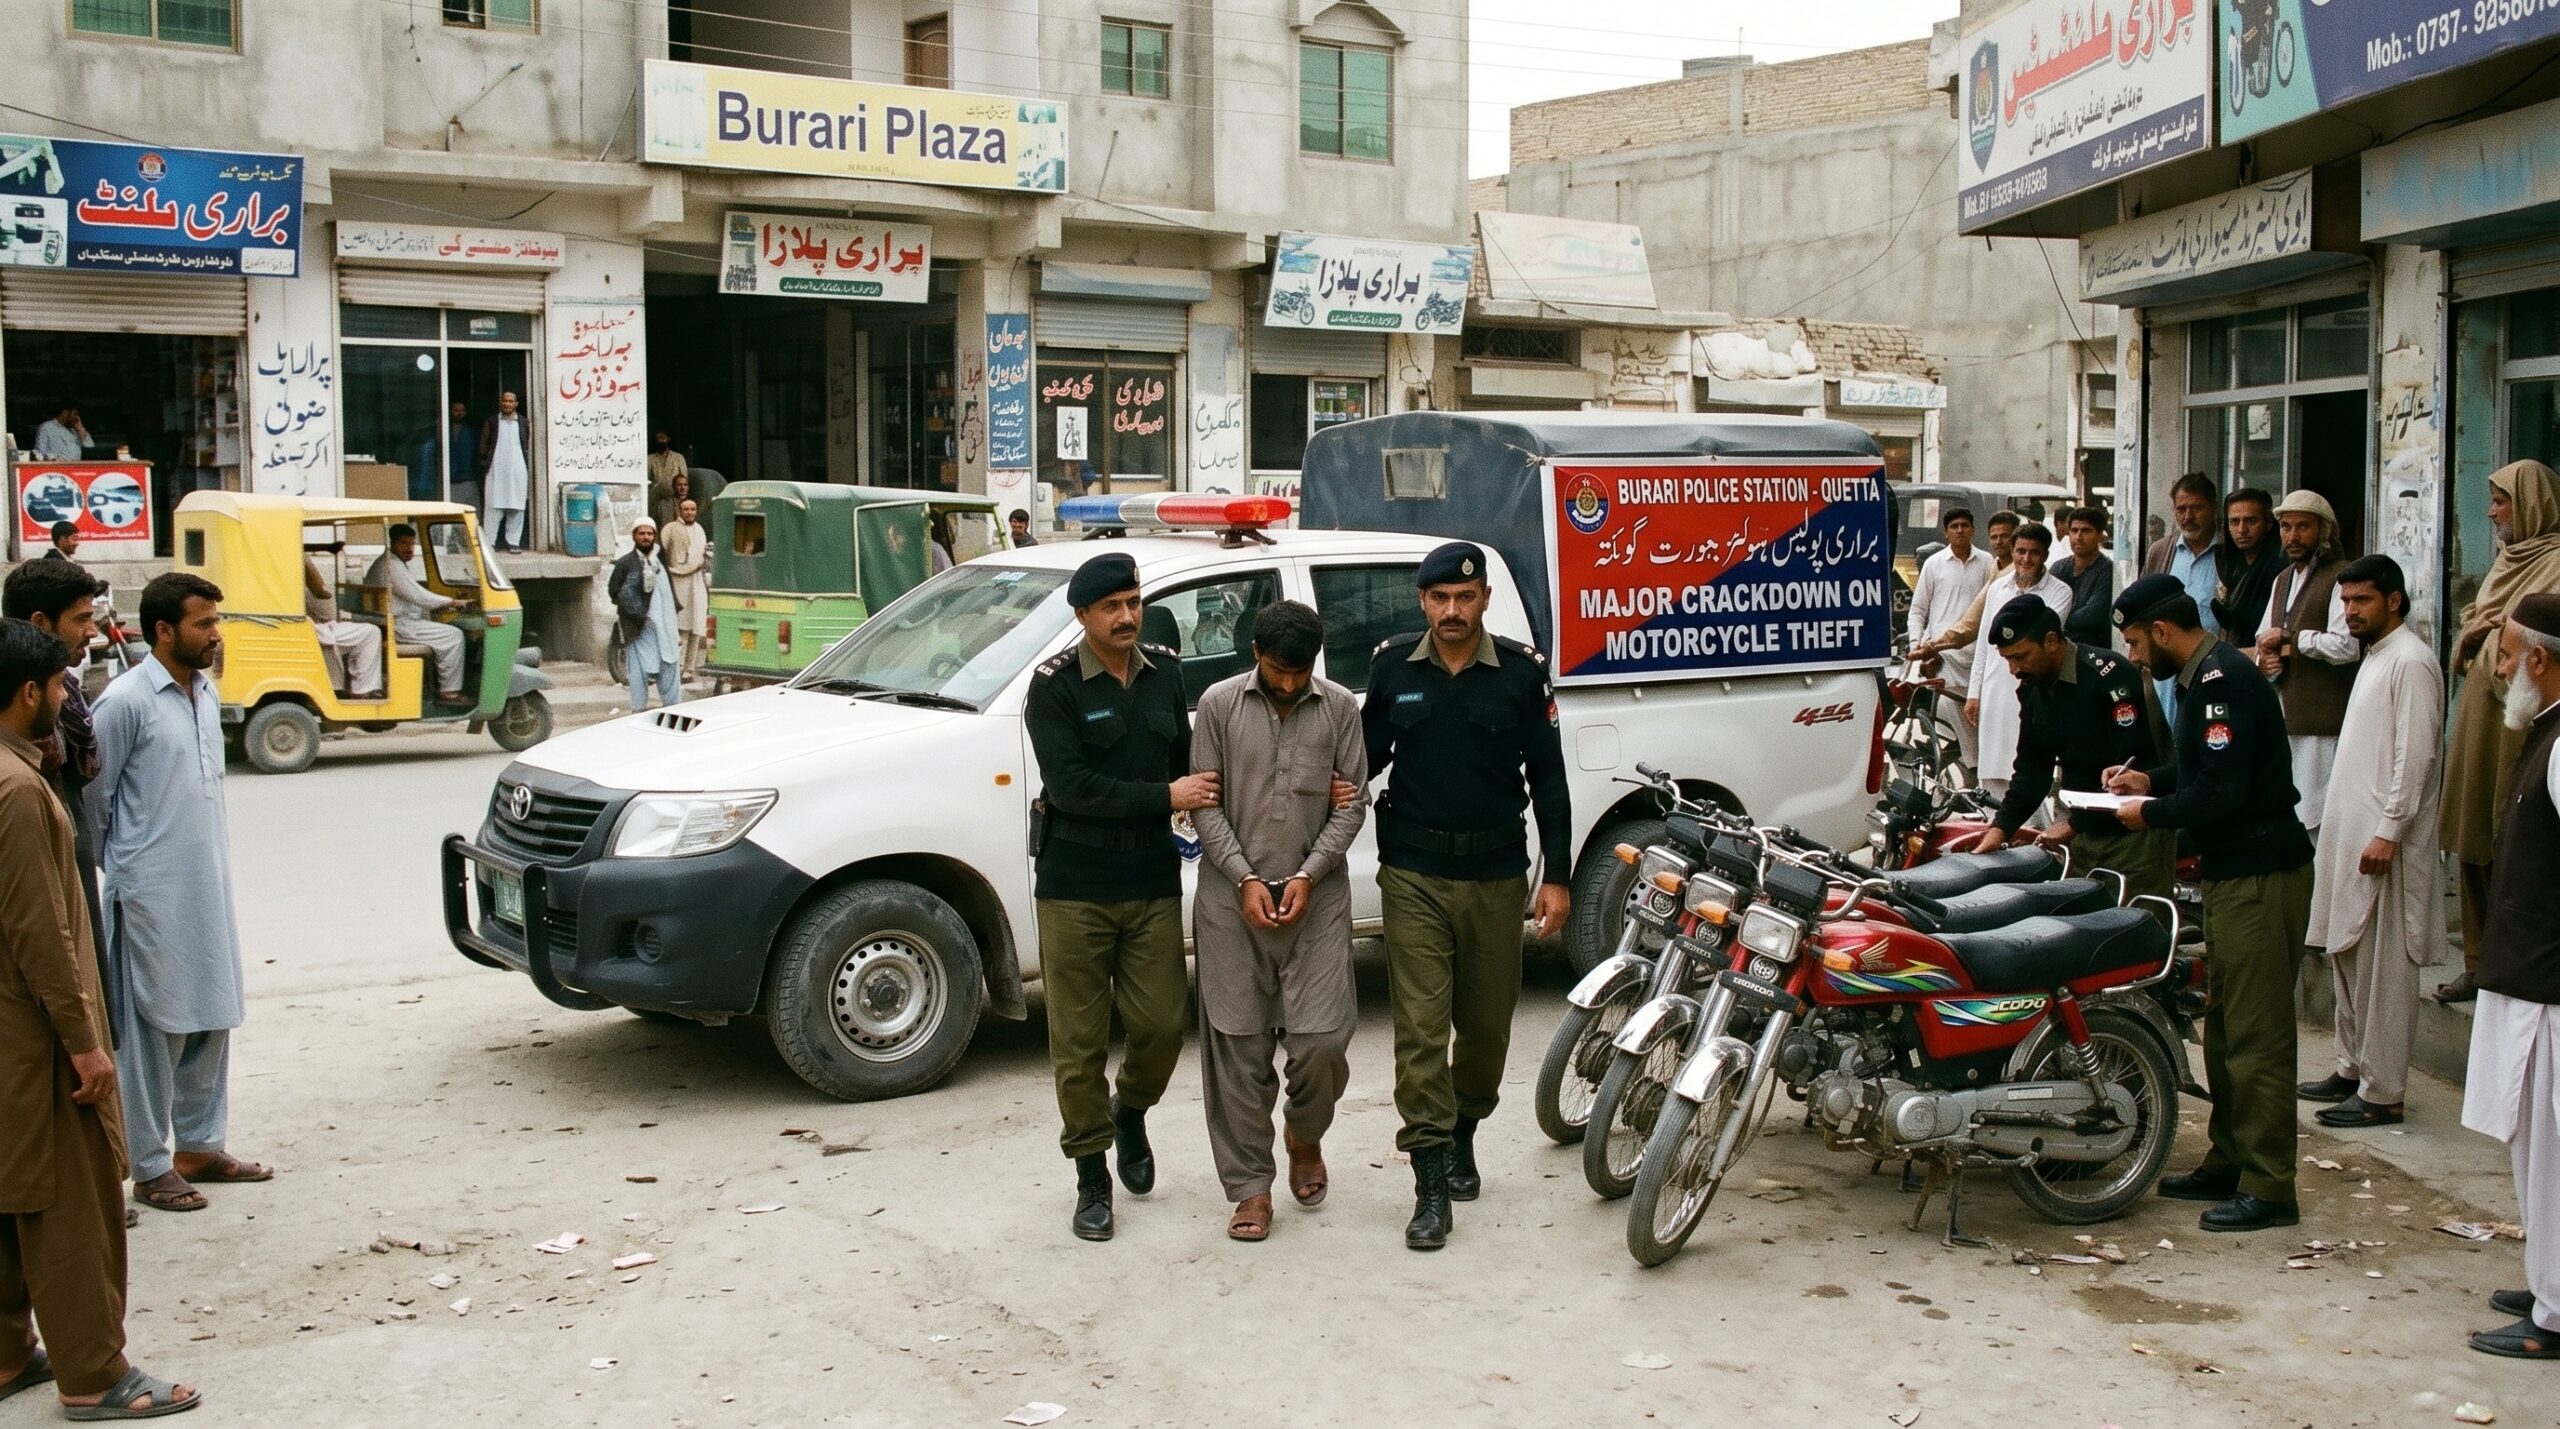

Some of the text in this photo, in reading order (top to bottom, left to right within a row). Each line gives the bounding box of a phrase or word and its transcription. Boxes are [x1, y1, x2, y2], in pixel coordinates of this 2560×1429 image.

[718, 90, 1007, 165] Burari Plaza
[184, 191, 290, 245] براری
[762, 222, 828, 276] پلازا
[1318, 257, 1421, 308] براری پلازا
[1617, 478, 1679, 505] BURARI
[1683, 478, 1740, 504] POLICE
[1743, 477, 1808, 502] STATION
[1821, 477, 1881, 502] QUETTA
[1771, 506, 1823, 574] پولیس
[1825, 524, 1880, 566] براری
[1580, 578, 1882, 619] MAJOR CRACKDOWN ON
[1606, 619, 1864, 661] MOTORCYCLE THEFT
